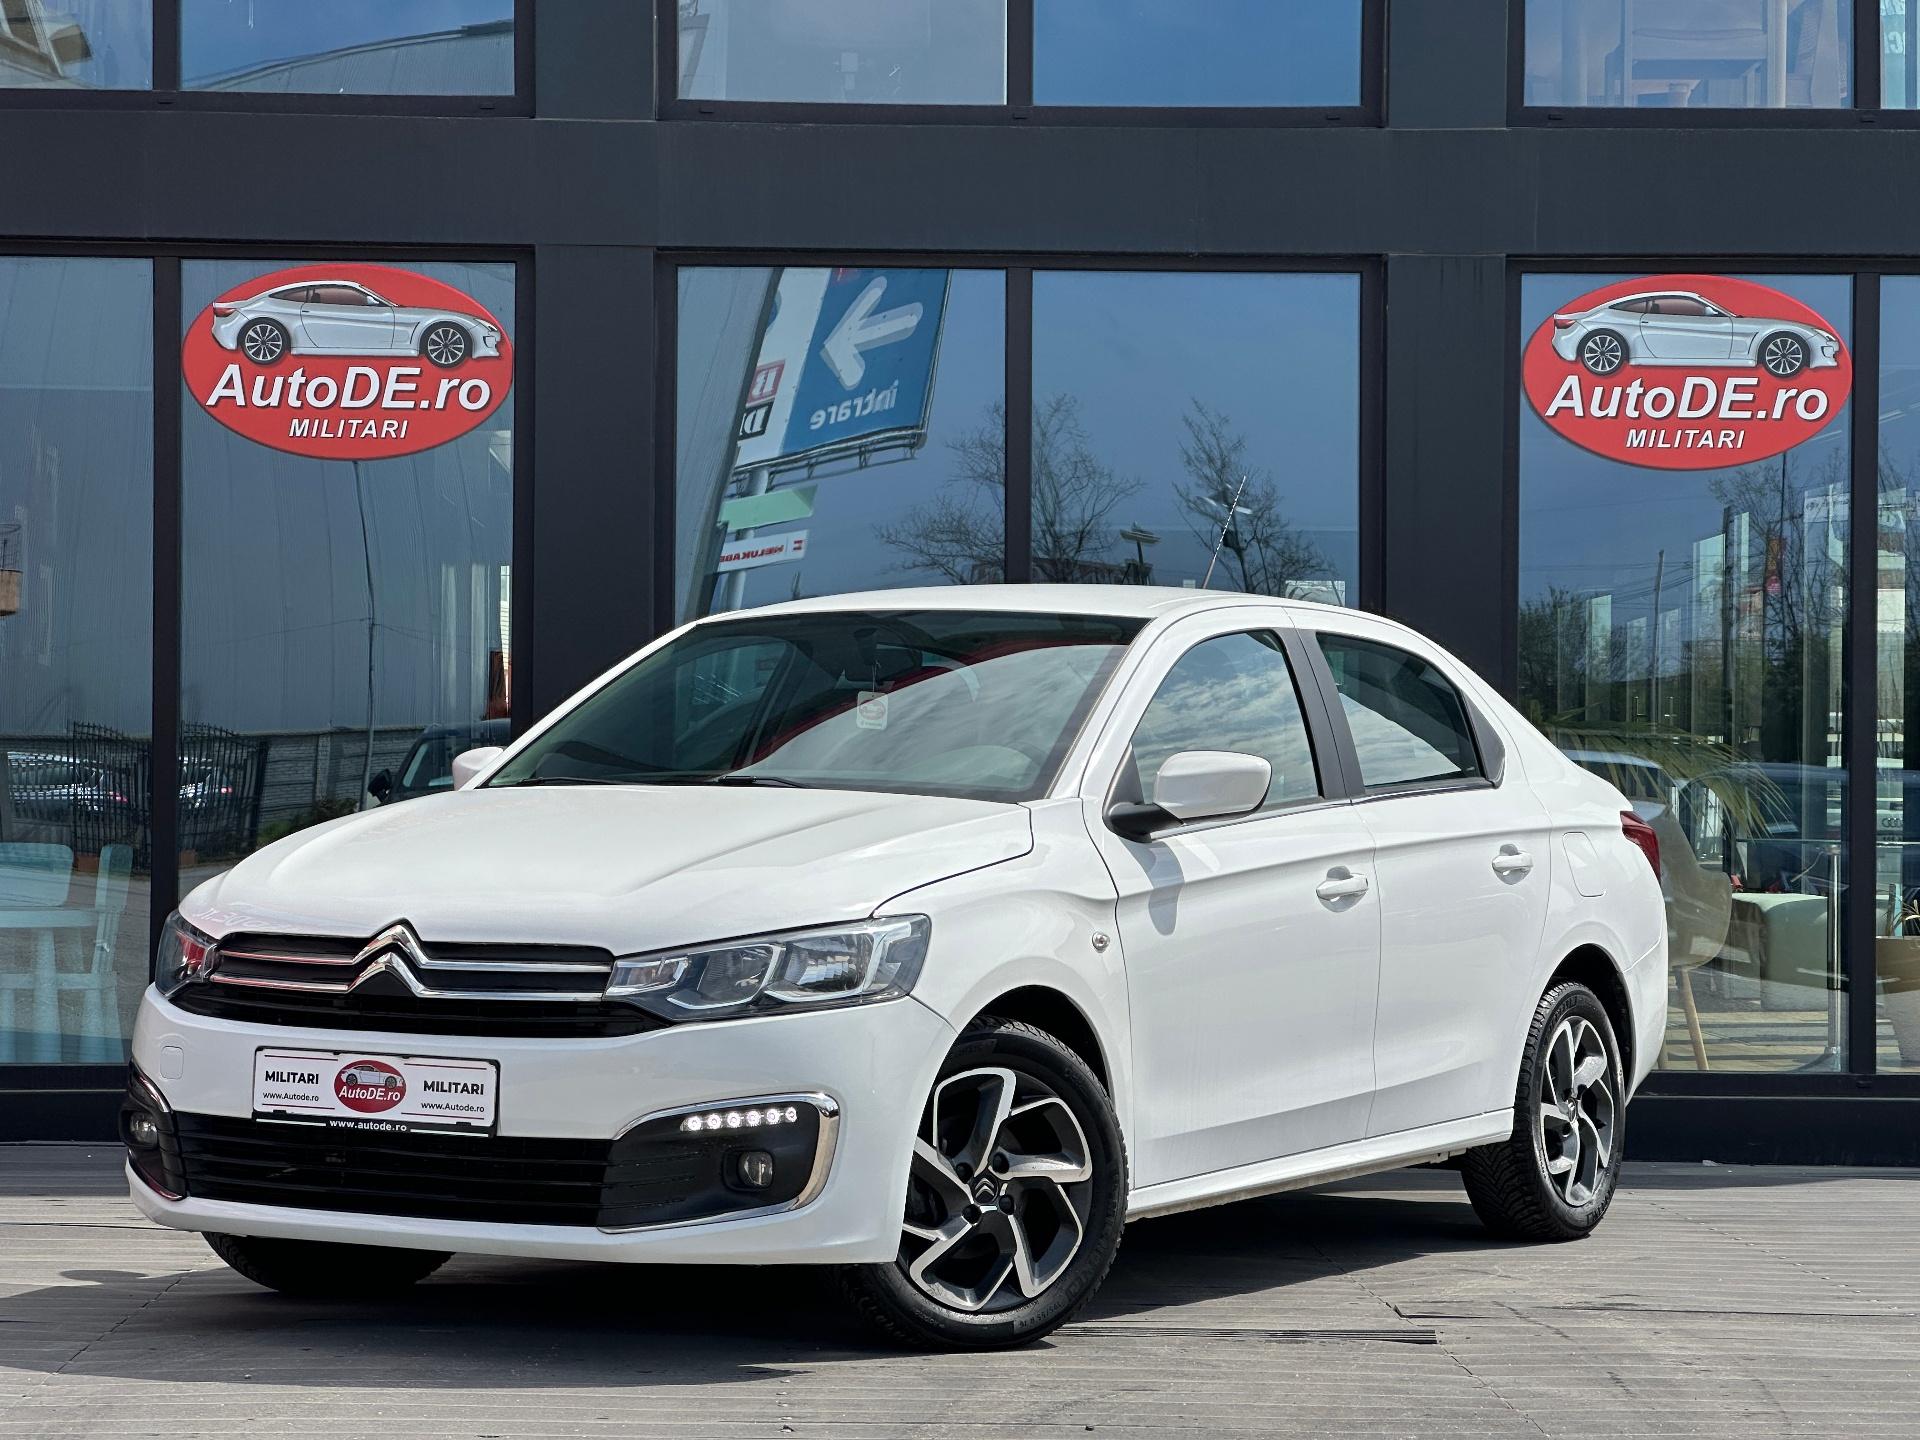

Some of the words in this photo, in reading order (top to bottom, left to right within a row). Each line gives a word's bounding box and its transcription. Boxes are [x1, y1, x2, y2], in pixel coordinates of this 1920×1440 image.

[206, 363, 491, 411] AutoDE.ro
[1545, 374, 1829, 421] AutoDE.ro
[288, 418, 409, 440] MILITARI
[1625, 429, 1746, 449] MILITARI
[264, 1070, 320, 1085] MILITARI
[338, 1085, 401, 1102] AutoDE.ro
[423, 1080, 485, 1096] MILITARI
[262, 1091, 320, 1102] www.Autode.ro
[420, 1101, 485, 1113] www.Autode.ro
[329, 1119, 408, 1133] www.autode.ro
